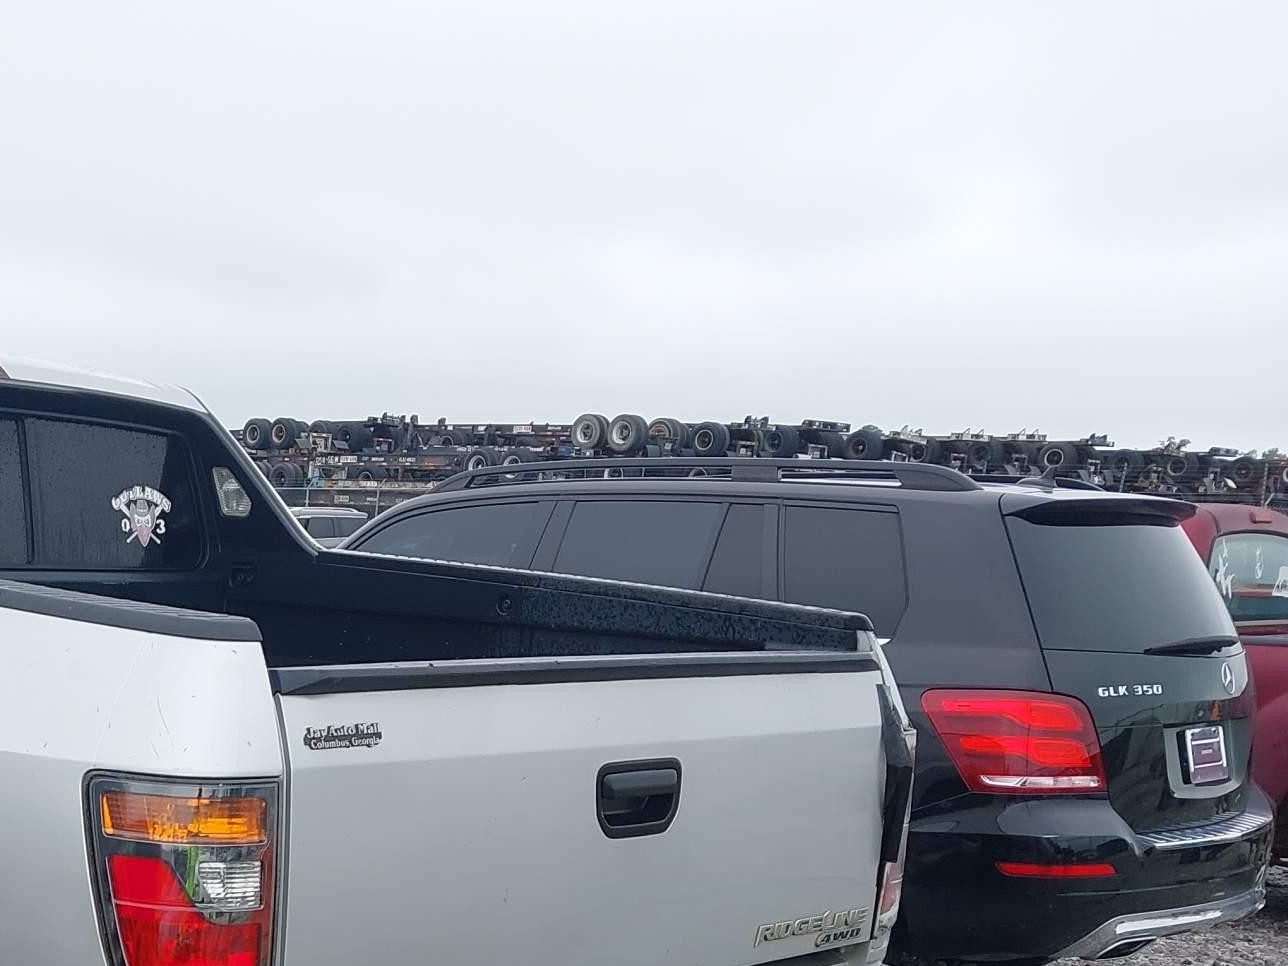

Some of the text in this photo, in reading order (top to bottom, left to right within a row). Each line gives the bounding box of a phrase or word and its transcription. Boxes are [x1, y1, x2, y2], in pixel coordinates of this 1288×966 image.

[112, 486, 172, 513] OUTLAWS
[156, 519, 166, 534] 3
[1098, 684, 1162, 697] GLK 350
[306, 722, 380, 740] Jay Auto Mall
[352, 736, 380, 747] Georgia
[754, 907, 870, 948] RIDGELINE
[815, 927, 862, 947] 4WD
